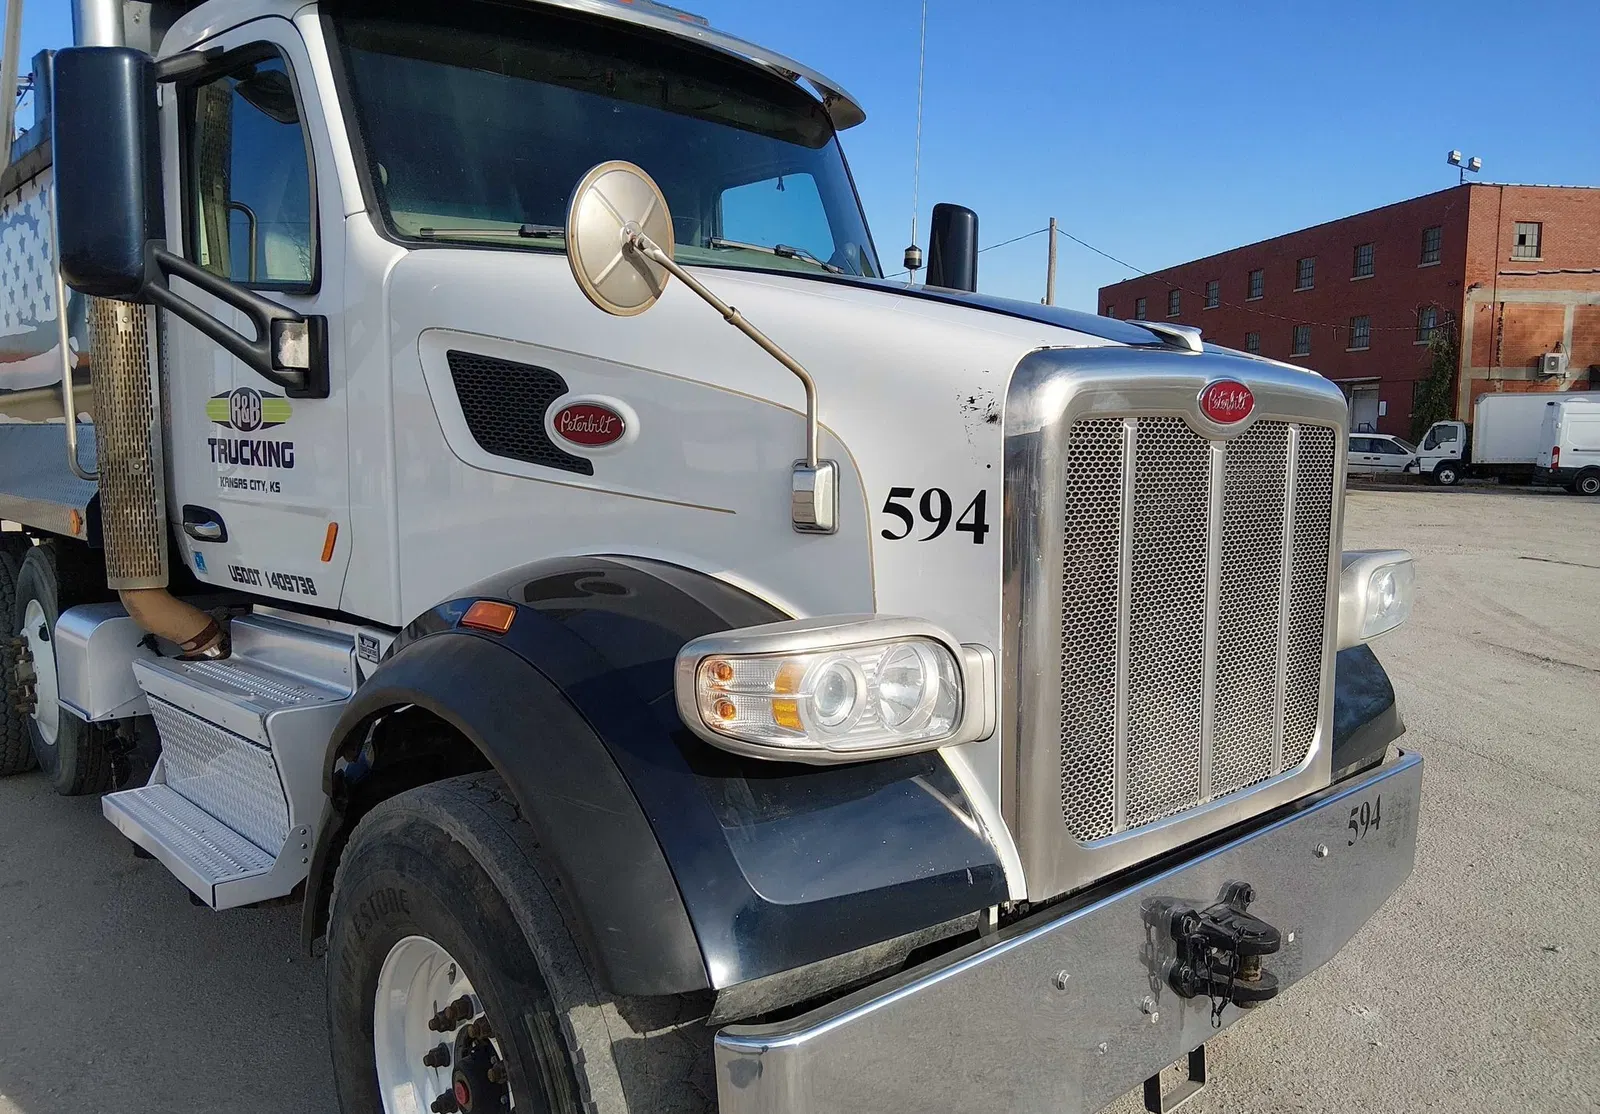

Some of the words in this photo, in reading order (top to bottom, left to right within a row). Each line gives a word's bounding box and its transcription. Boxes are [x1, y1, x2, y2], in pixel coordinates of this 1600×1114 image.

[231, 391, 261, 428] R&B
[561, 410, 616, 434] Peterbilt
[207, 438, 295, 469] TRUCKING
[220, 476, 248, 490] KANSAS
[249, 479, 267, 494] CITY,
[270, 481, 281, 493] KS
[881, 486, 990, 545] 594
[227, 563, 263, 587] USDOT
[264, 570, 318, 596] 1409738
[1347, 793, 1381, 846] 594
